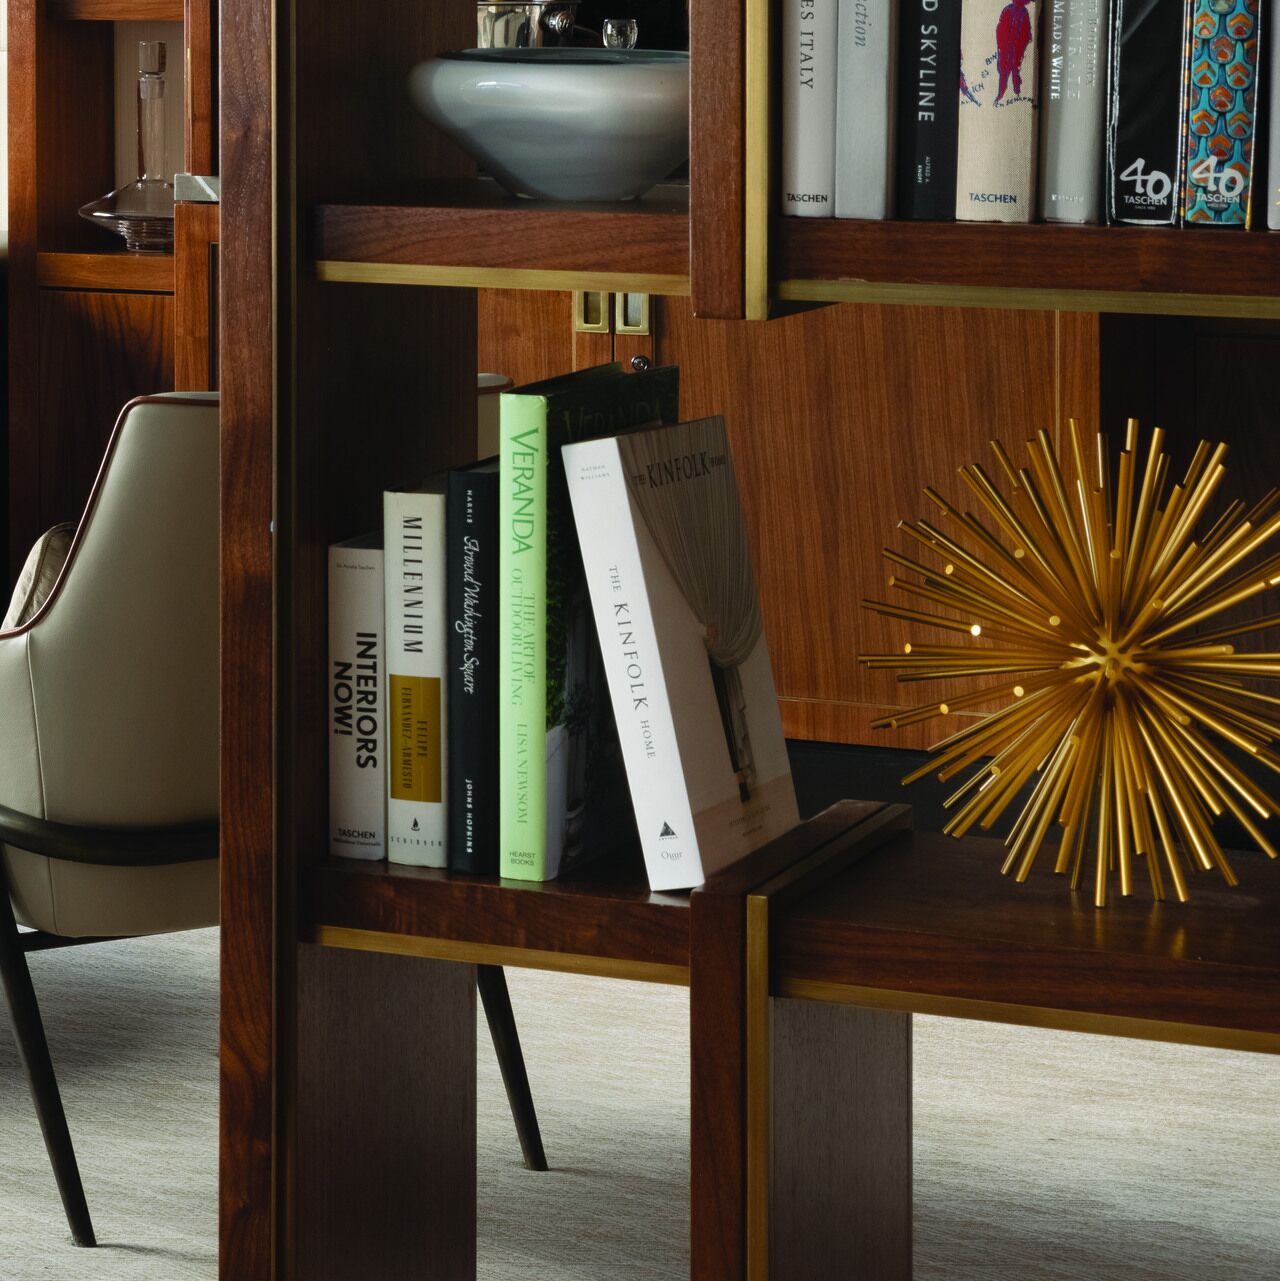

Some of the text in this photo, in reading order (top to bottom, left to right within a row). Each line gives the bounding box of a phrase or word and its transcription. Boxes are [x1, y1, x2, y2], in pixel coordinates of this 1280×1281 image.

[1053, 0, 1065, 40] MEAD
[799, 29, 815, 90] ITALY
[918, 24, 937, 122] SKYLINE
[1050, 56, 1064, 100] WHITE
[786, 193, 828, 203] TASCHEN
[968, 193, 1017, 204] TASCHEN
[1120, 158, 1172, 201] 40
[1192, 155, 1244, 199] 40
[1196, 193, 1240, 203] TASCHEN
[1123, 195, 1168, 206] TASCHEN
[510, 426, 539, 556] VERANDA
[647, 451, 711, 489] KINFOLK
[402, 515, 423, 654] MILLENNIUM
[458, 536, 481, 694] Around Washington Square
[510, 568, 523, 706] OUTDOOR LIVING
[523, 593, 536, 684] THE ART OF
[608, 564, 656, 759] THE KINFOLK HOME
[334, 661, 353, 737] NOW!
[355, 631, 378, 769] INTERIORS
[417, 720, 428, 757] FELIPE
[465, 779, 473, 809] JOHNS
[516, 724, 528, 825] LISA NEWSOM
[337, 829, 376, 840] TASCHEN
[509, 850, 536, 859] HEARST
[510, 857, 535, 866] BOOKS
